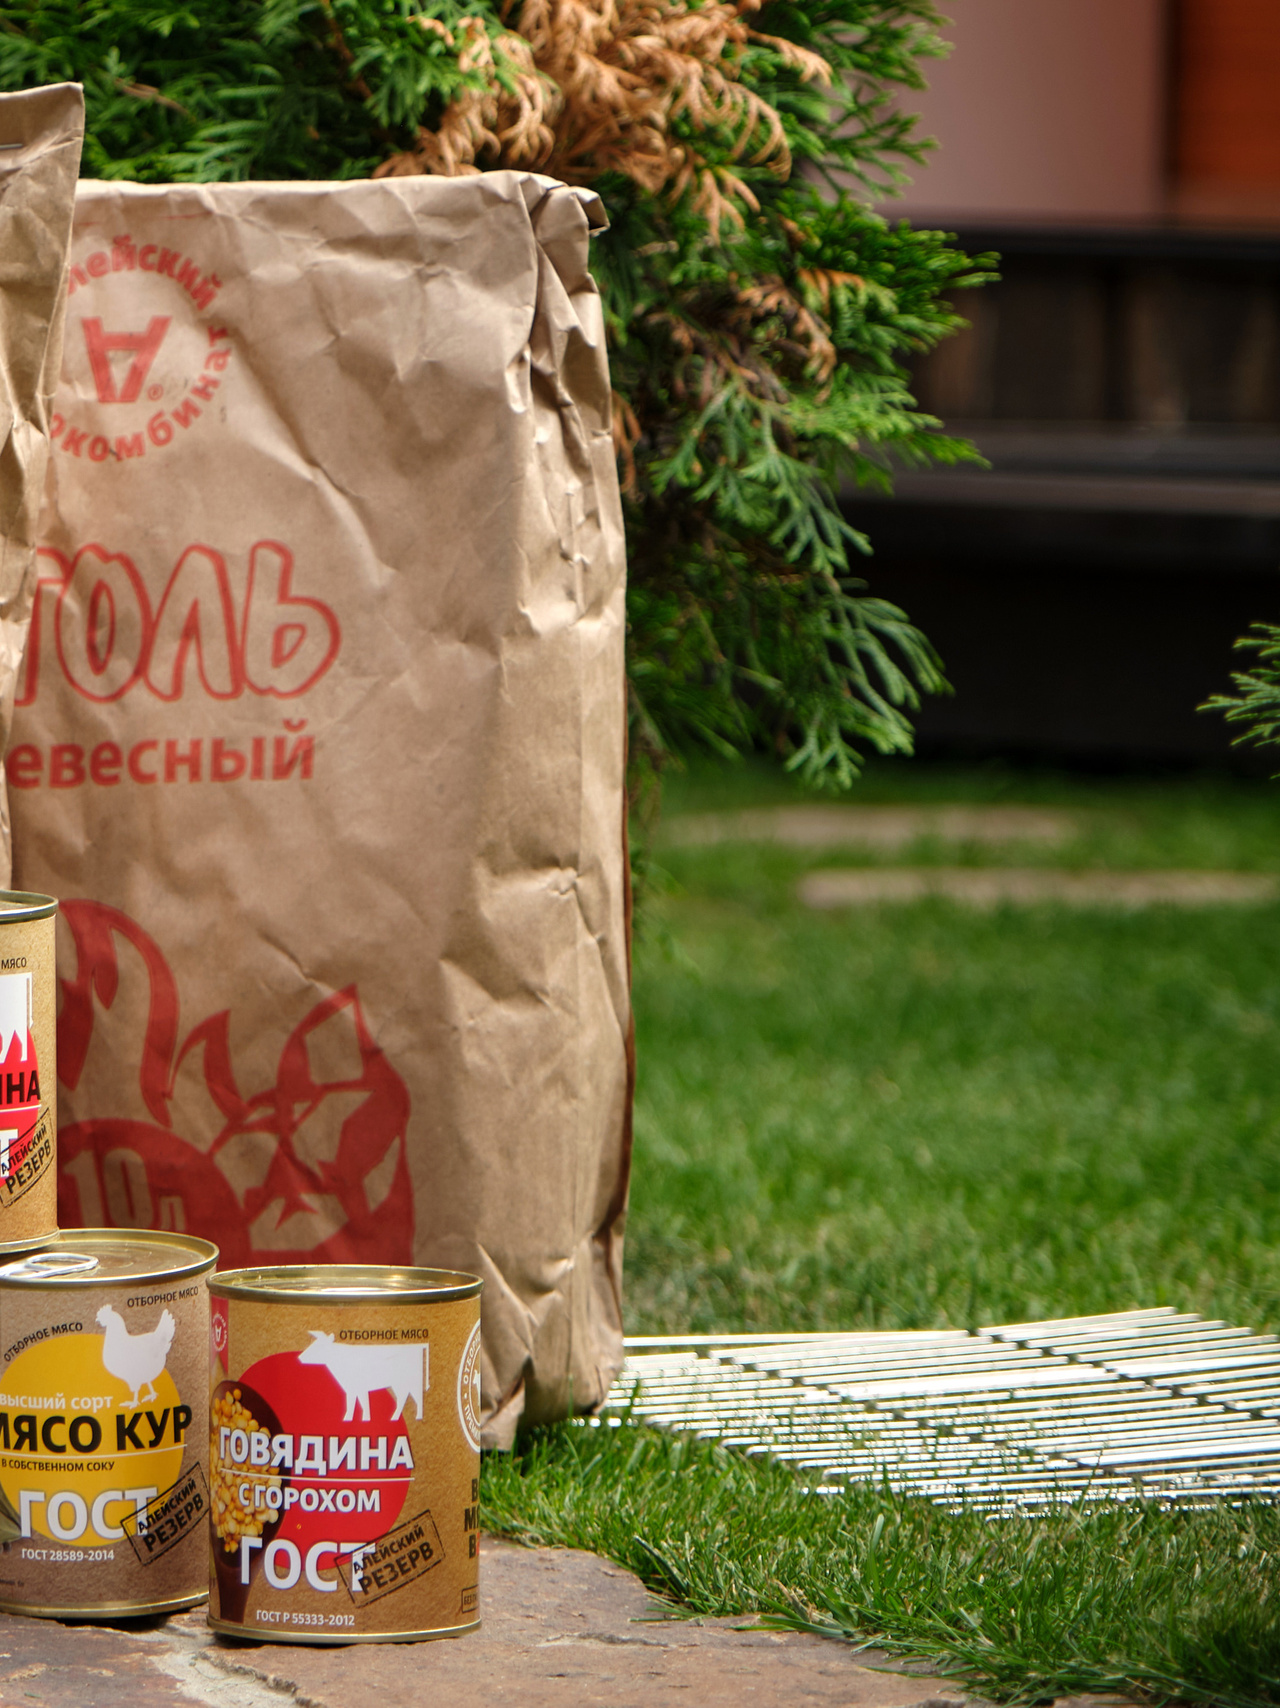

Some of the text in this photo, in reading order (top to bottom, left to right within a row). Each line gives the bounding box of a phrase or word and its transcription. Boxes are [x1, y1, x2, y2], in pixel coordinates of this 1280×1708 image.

[67, 234, 223, 311] лейский
[50, 326, 233, 462] окомбинат
[14, 539, 342, 708] ГОЛЬ
[4, 718, 316, 790] евесный
[1, 957, 27, 970] МЯСО
[1, 1122, 47, 1175] АЛЕЙСКИЙ
[5, 1138, 51, 1195] РЕЗЕРВ
[126, 1285, 199, 1308] ОТБОРНОЕ МЯСО
[3, 1321, 83, 1362] ОТБОРНОЕ МЯСО
[339, 1328, 429, 1340] ОТБОРНОЕ МЯСО
[71, 1395, 114, 1413] сорт
[116, 1404, 193, 1452] КУР
[1, 1458, 115, 1472] В СОБСТВЕННОМ СОКУ
[220, 1426, 415, 1476] ГОВЯДИНА
[19, 1487, 158, 1541] ГОСТ
[138, 1477, 197, 1534] АЛЕЙСКИЙ
[143, 1493, 204, 1552] РЕЗЕРВ
[238, 1483, 381, 1513] С ГОРОХОМ
[21, 1548, 115, 1562] ГОСТ 28589-2014
[240, 1535, 377, 1593] ГОСТ
[352, 1524, 425, 1574] АЛЕЙСКИЙ
[357, 1541, 434, 1596] РЕЗЕРВ
[256, 1609, 355, 1626] ГОСТ Р 55333-2012
